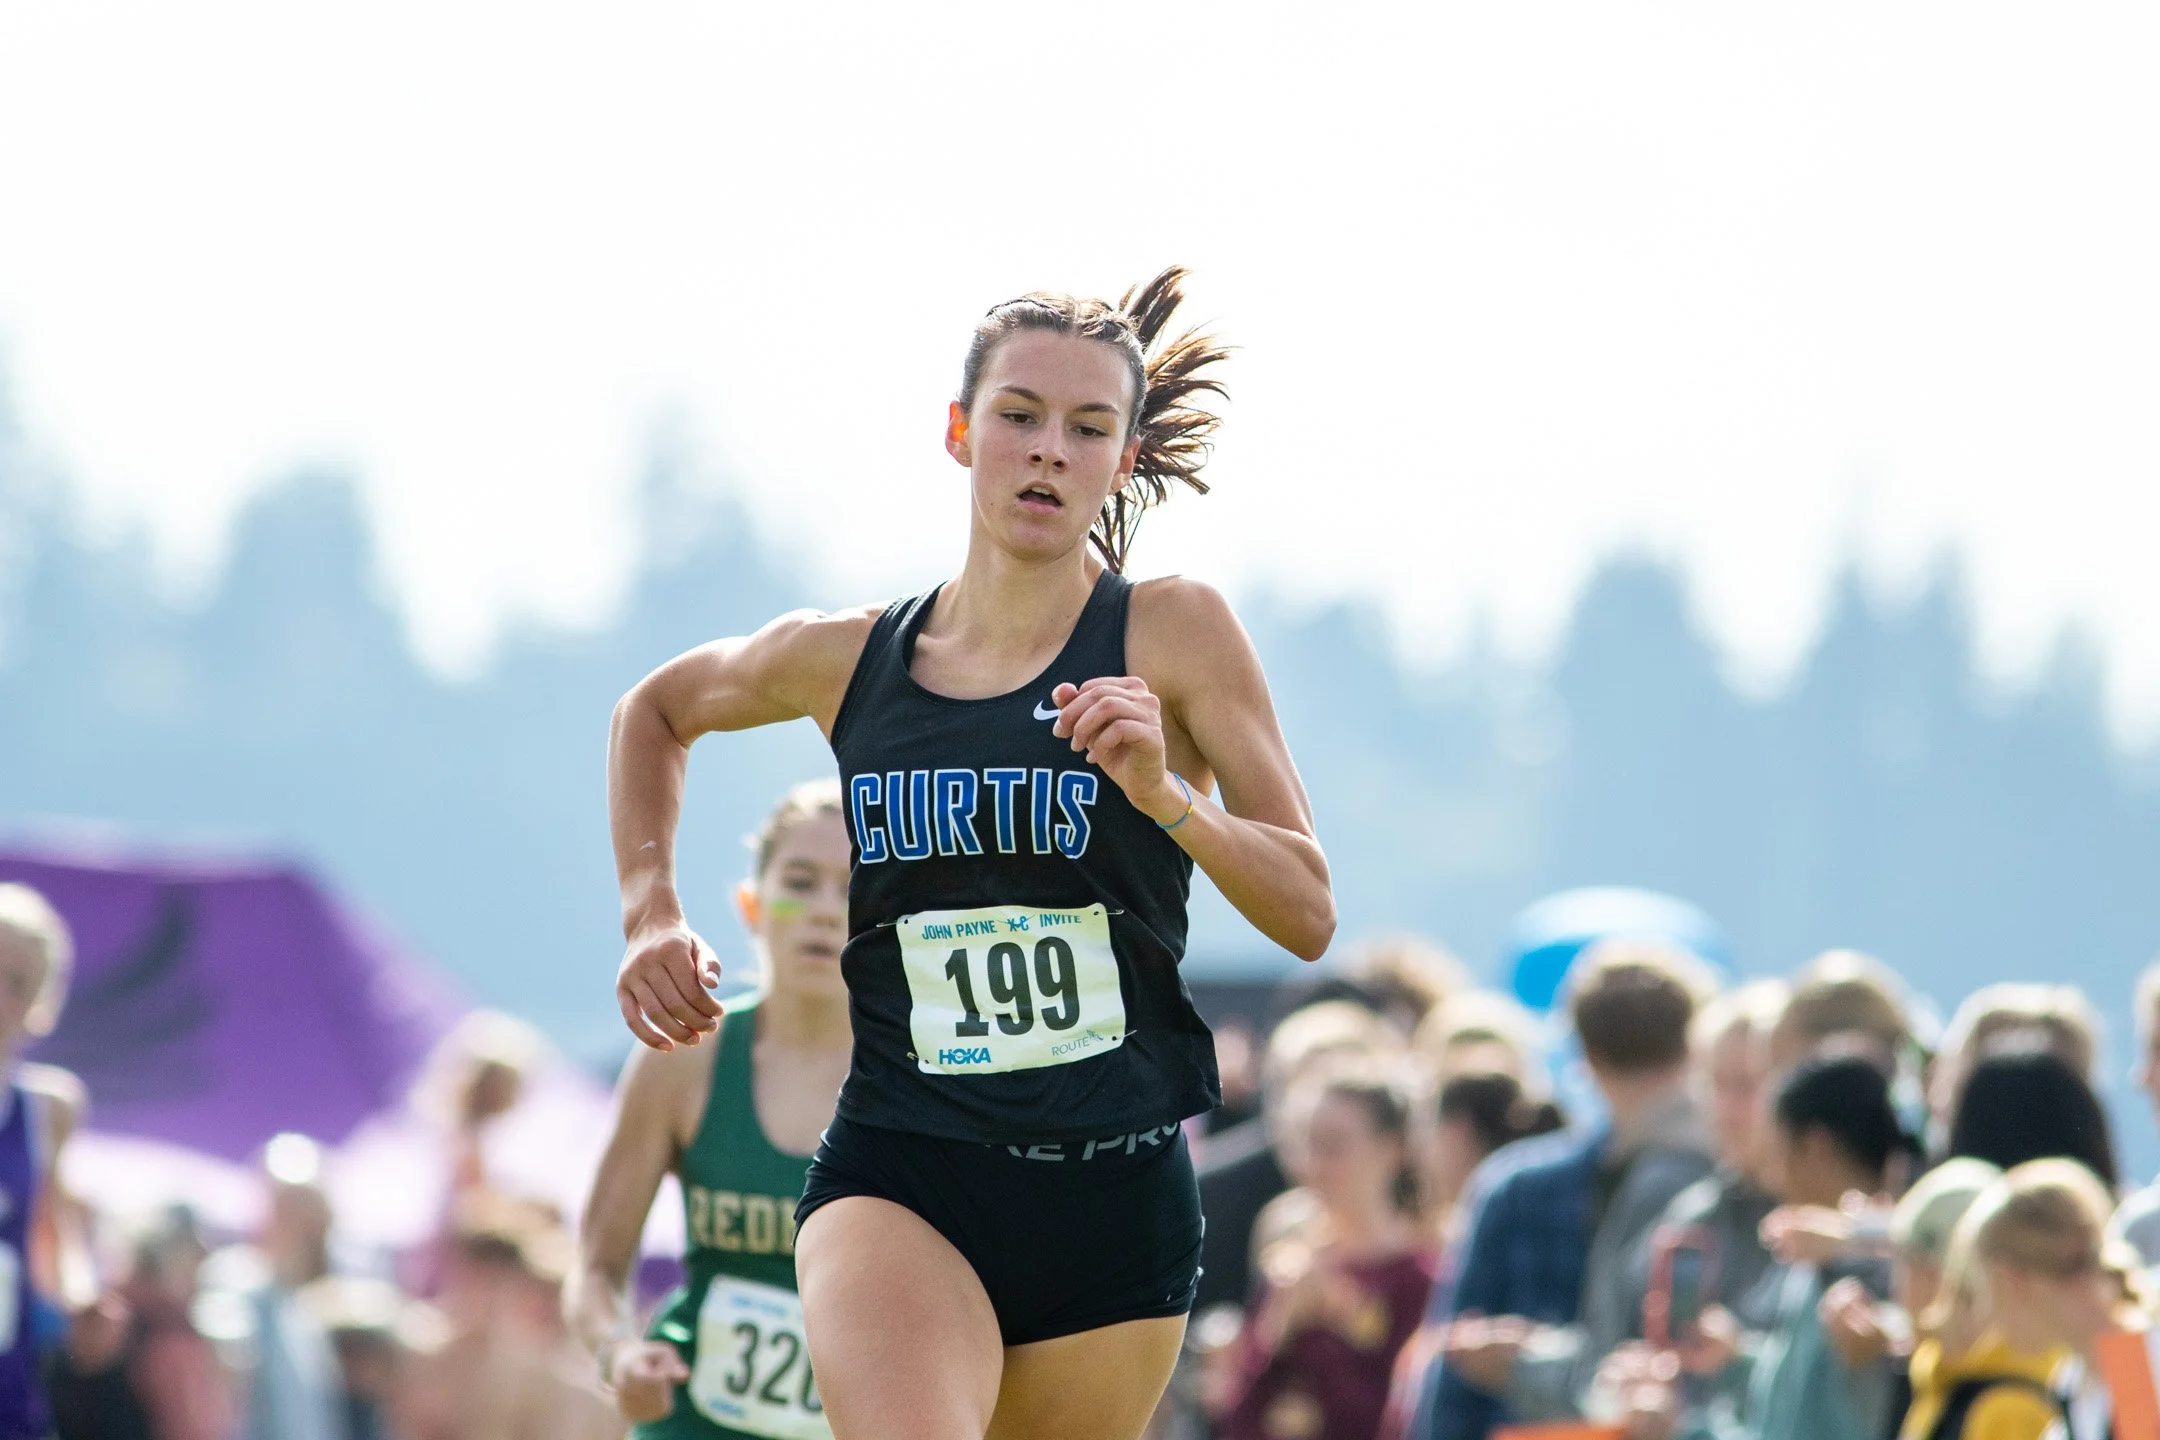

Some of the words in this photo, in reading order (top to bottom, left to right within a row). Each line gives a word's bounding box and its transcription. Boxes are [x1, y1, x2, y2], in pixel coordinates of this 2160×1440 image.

[851, 767, 1098, 864] CURTIS
[922, 924, 952, 940] JOHN
[956, 920, 998, 938] PAYNE
[1039, 913, 1082, 928] INVITE
[944, 936, 1081, 1038] 199
[938, 1047, 992, 1065] HOKA
[1052, 1036, 1090, 1057] ROUTE
